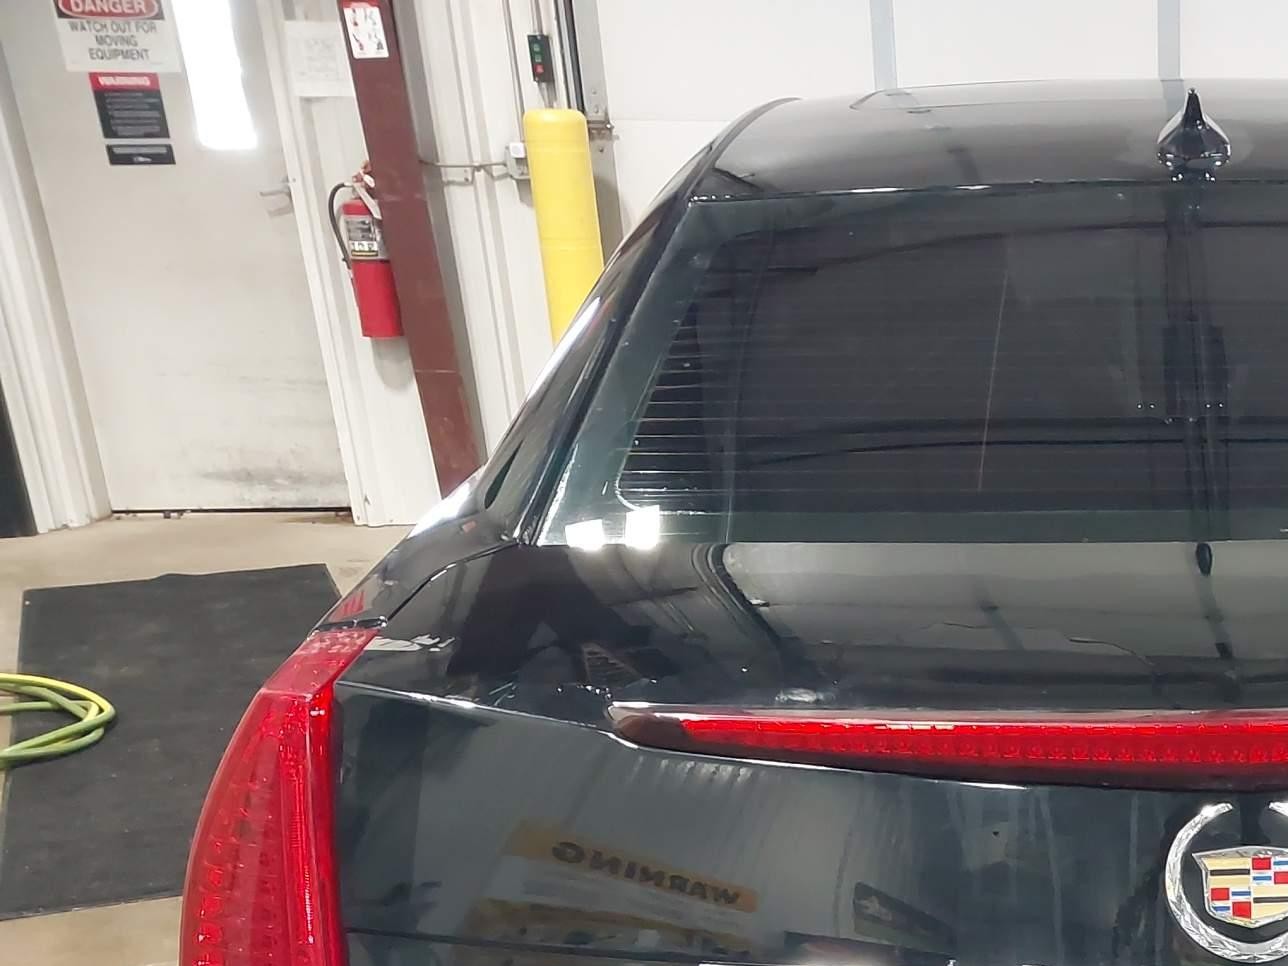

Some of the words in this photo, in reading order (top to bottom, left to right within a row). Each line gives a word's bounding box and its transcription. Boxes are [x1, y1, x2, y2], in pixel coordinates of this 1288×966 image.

[70, 0, 147, 13] DANGER
[68, 21, 109, 33] WATCH
[111, 21, 132, 33] OUT
[136, 21, 157, 33] FOR
[95, 35, 139, 47] MOVING
[88, 48, 150, 60] EQUIPMENT
